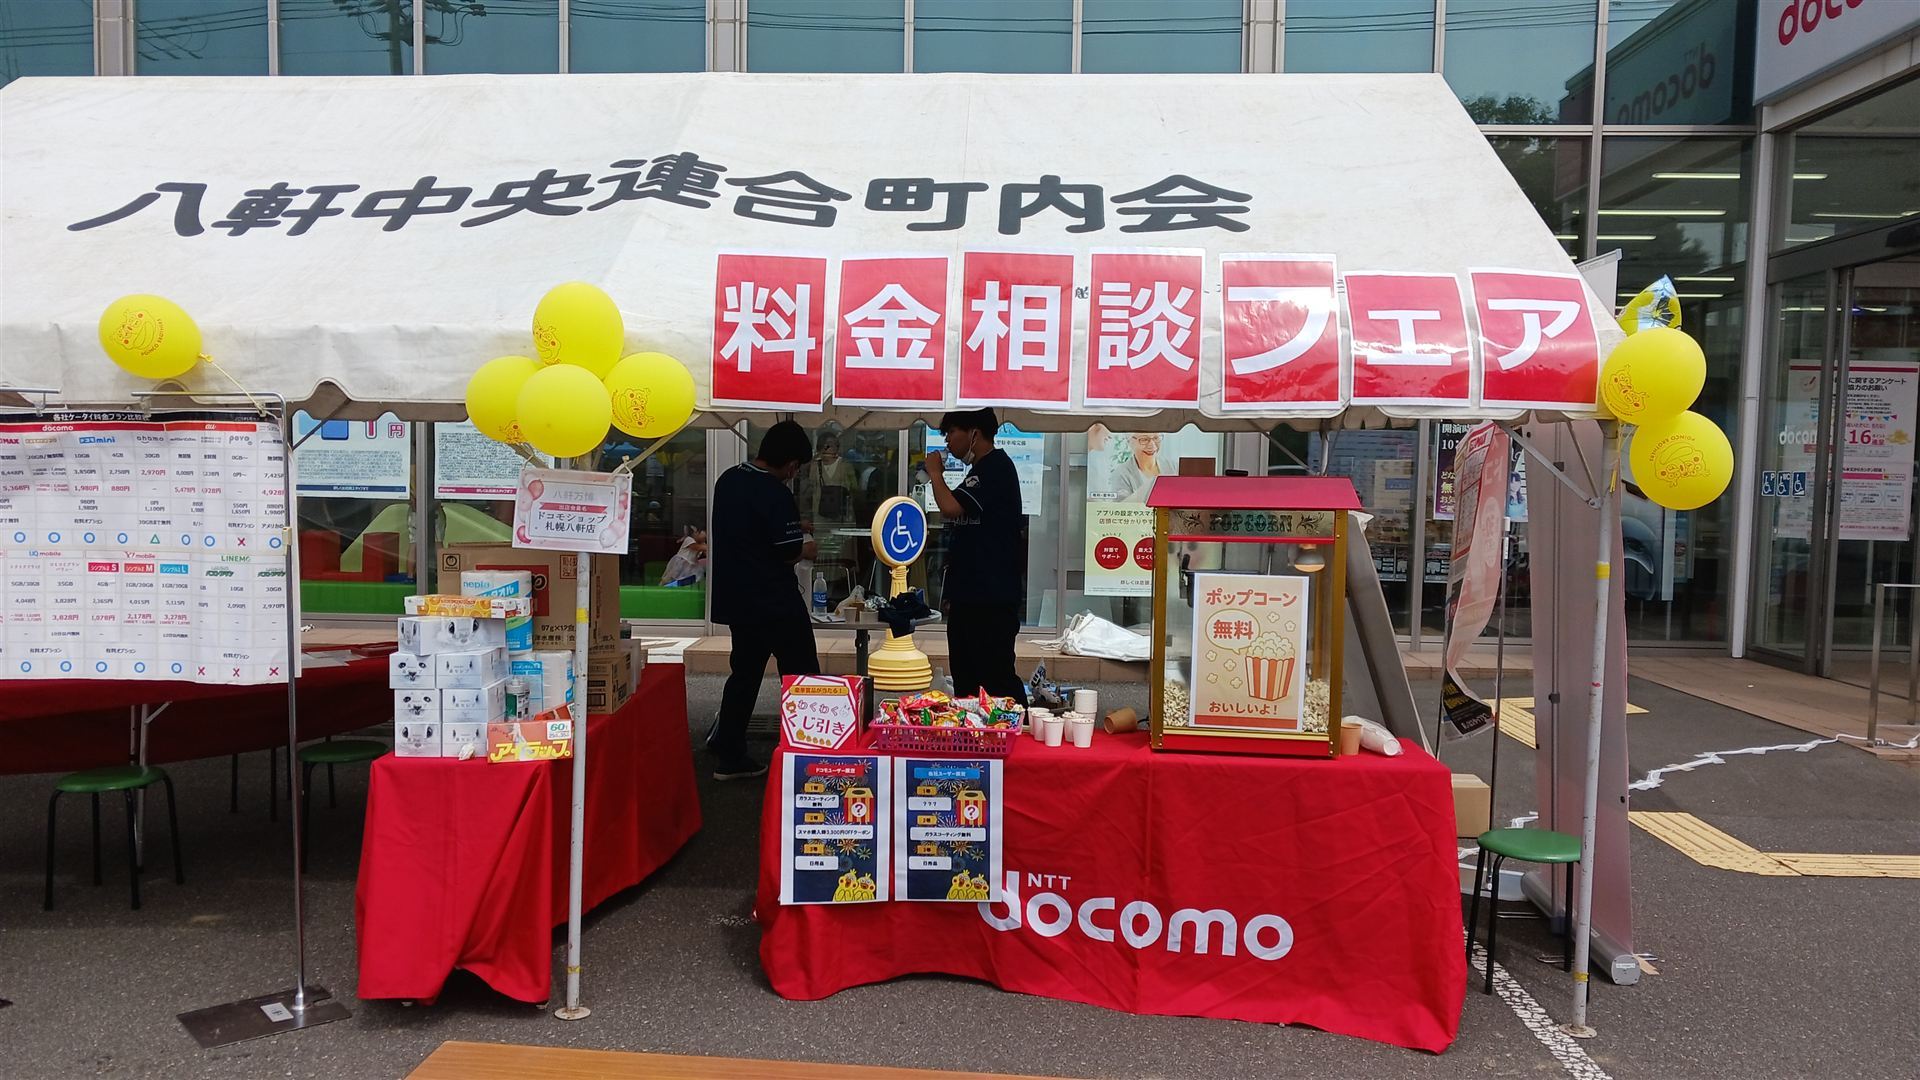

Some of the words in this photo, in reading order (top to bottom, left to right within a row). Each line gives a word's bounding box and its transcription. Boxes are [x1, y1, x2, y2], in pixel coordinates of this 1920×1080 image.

[67, 152, 1253, 236] 八軒中央連合町内会
[719, 281, 1582, 376] 料金相談フェア
[1848, 377, 1907, 385] に関するアンケート
[42, 424, 74, 432] docomo
[136, 436, 164, 444] ahamo
[1849, 430, 1872, 445] 16
[74, 484, 100, 492] 1,980円
[111, 484, 130, 492] 880円
[538, 511, 607, 524] ドコモショップ
[1208, 513, 1294, 533] POPCORN
[545, 521, 596, 533] 札幌八軒店
[111, 563, 118, 571] S
[145, 563, 154, 572] M
[181, 564, 188, 572] L
[1205, 587, 1298, 608] ポップコーン
[1213, 619, 1254, 641] 無料
[797, 700, 839, 717] わくわく
[1208, 701, 1278, 715] おいしいよ!
[787, 714, 846, 736] くじ引き
[1027, 873, 1071, 890] NTT
[977, 870, 1294, 961] docomo
